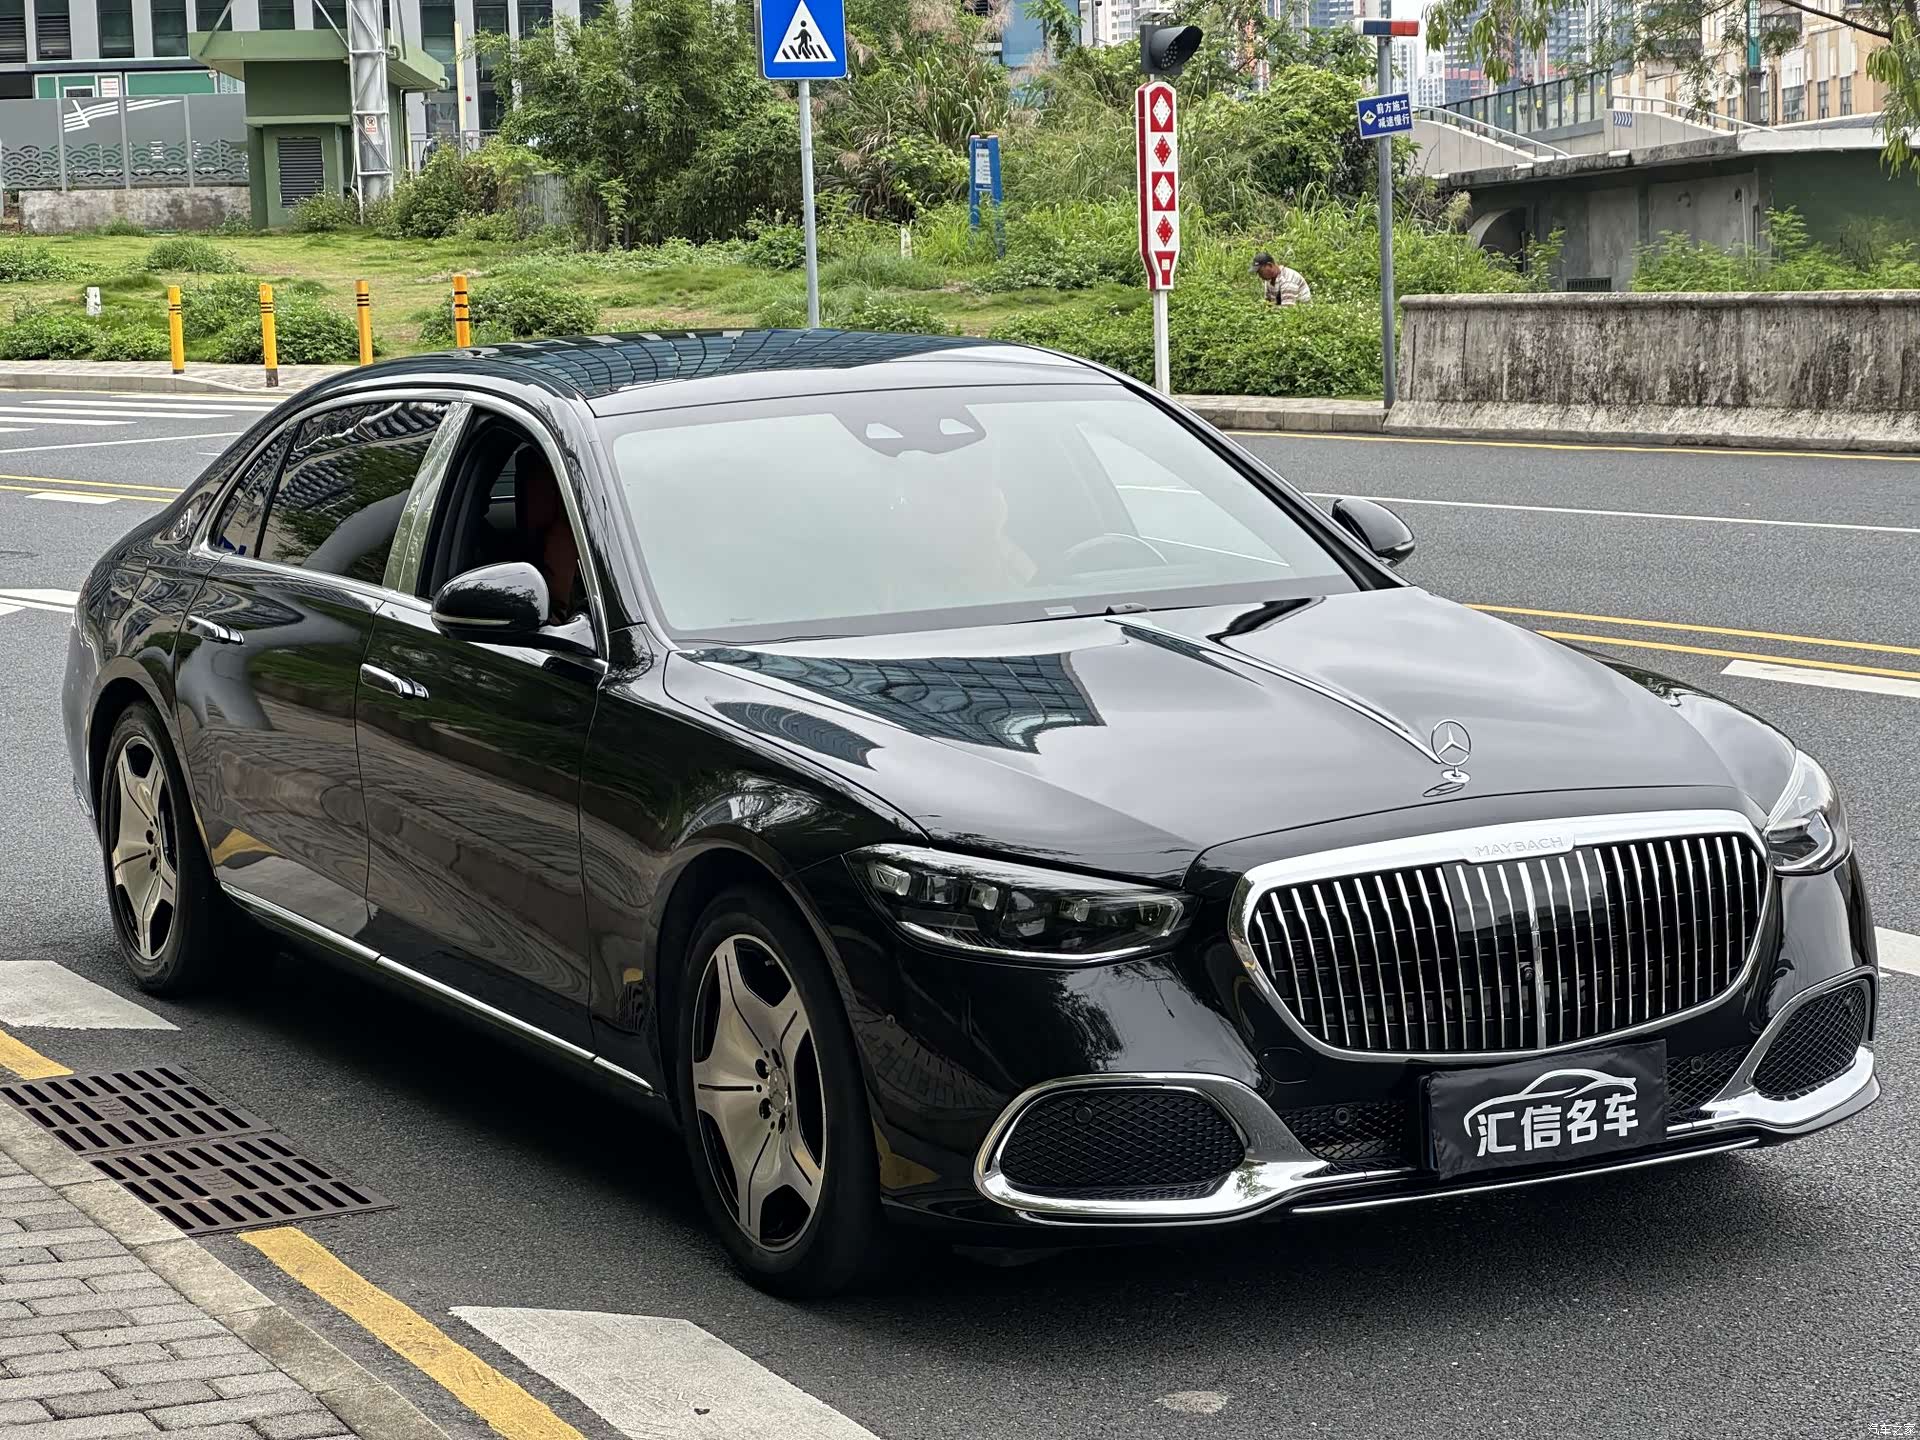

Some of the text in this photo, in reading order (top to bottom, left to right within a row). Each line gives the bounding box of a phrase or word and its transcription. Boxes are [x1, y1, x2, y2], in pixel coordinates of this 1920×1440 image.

[1376, 99, 1409, 115] 前方施工
[1378, 113, 1410, 129] 减速慢行
[1475, 836, 1564, 857] MAYBACH
[1476, 1092, 1640, 1157] 汇信名车
